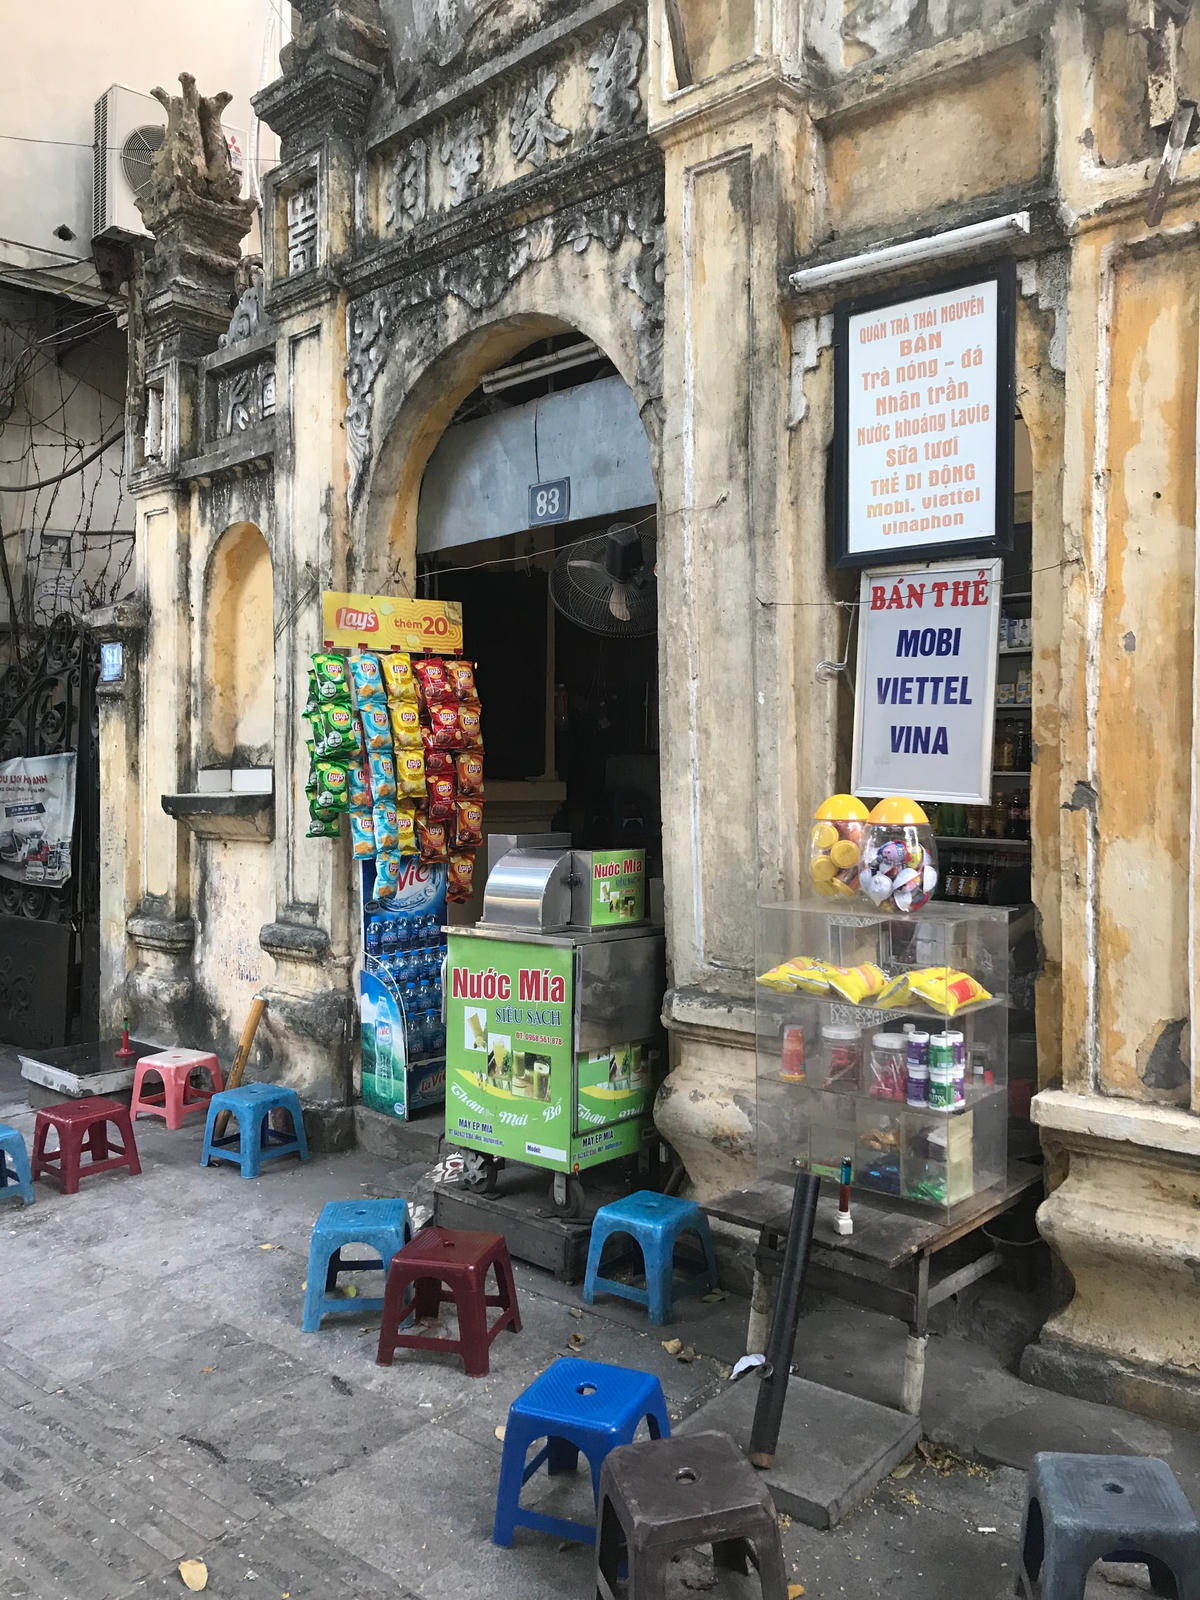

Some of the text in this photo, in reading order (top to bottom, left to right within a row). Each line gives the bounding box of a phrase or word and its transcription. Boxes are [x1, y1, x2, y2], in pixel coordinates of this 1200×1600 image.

[860, 295, 985, 344] QUÁN TRÀ THÁI NGUYÊN
[900, 331, 942, 357] BÁN
[861, 366, 890, 391] Trà
[896, 358, 938, 384] nóng
[961, 344, 983, 368] đá
[875, 377, 969, 416] Nhân trần
[857, 423, 890, 446] Nước
[895, 412, 946, 438] khoáng
[886, 436, 959, 467] Sữa tươi
[871, 463, 976, 496] THẺ DI ĐỘNG
[536, 487, 560, 517] 83
[882, 512, 964, 535] vinaphon
[871, 570, 990, 611] BÁN THẺ
[339, 608, 376, 631] Lay's
[393, 618, 423, 630] thêm
[105, 647, 119, 665] 81
[896, 627, 962, 658] MOBI
[877, 676, 972, 705] VIETTEL
[890, 725, 949, 755] VINA
[594, 861, 620, 879] Nước
[453, 967, 565, 1003] Nước Mía
[495, 1004, 562, 1027] SIÊU SẠCH
[542, 1097, 562, 1122] Bổ
